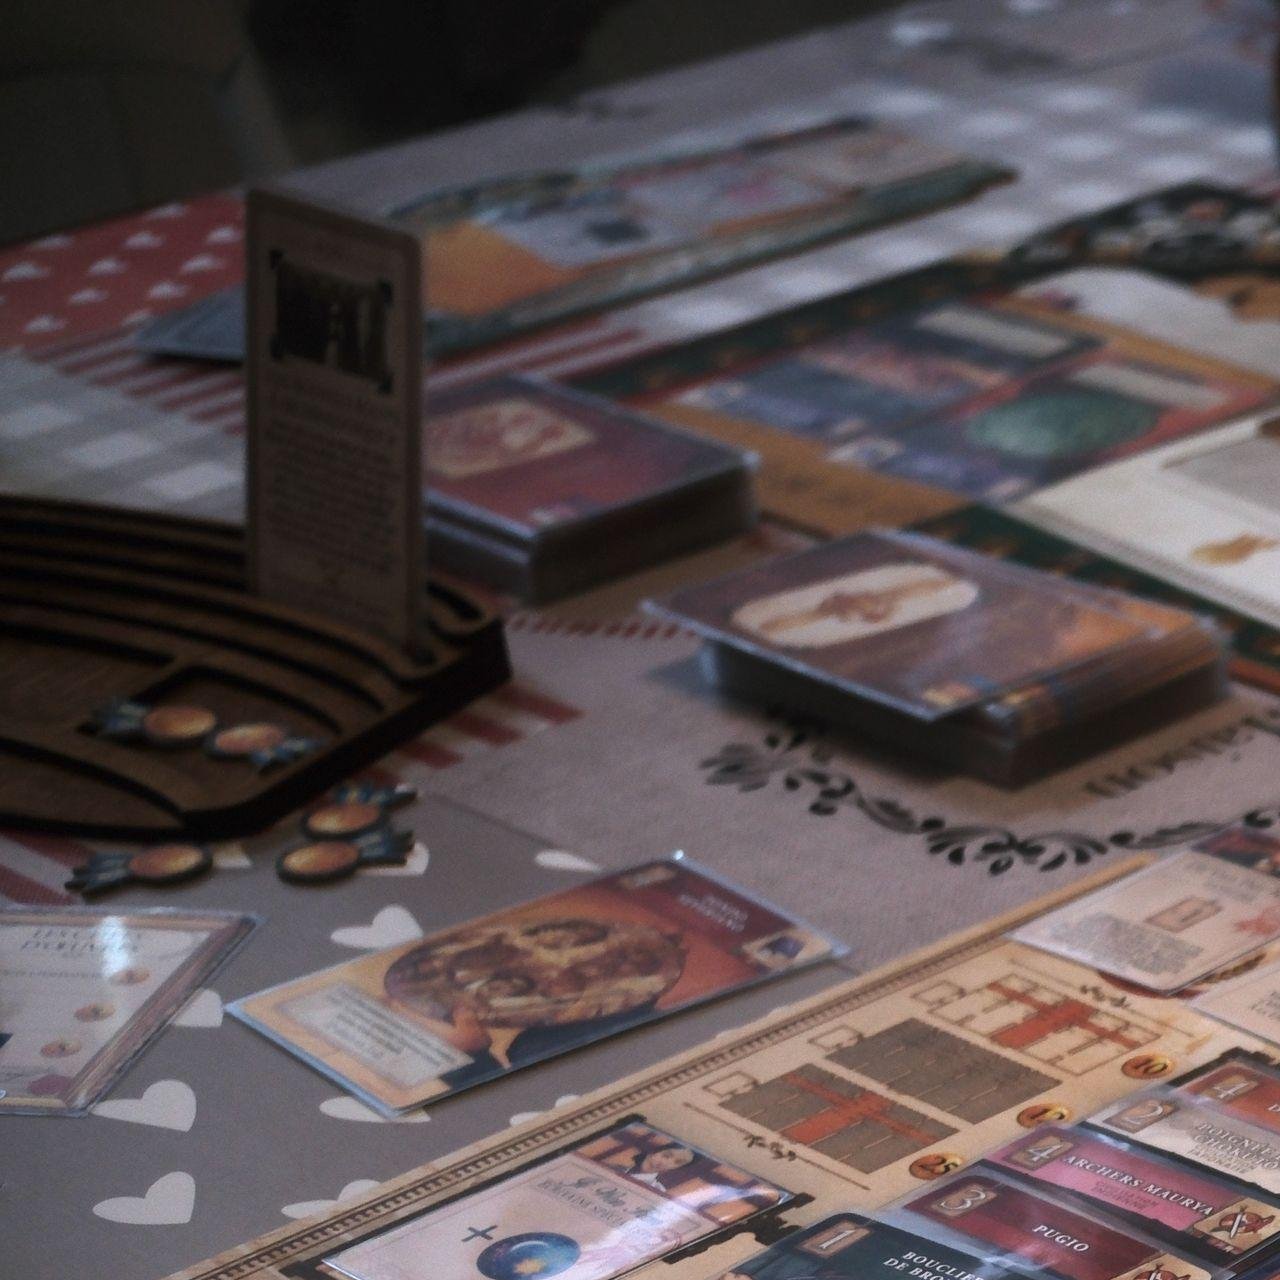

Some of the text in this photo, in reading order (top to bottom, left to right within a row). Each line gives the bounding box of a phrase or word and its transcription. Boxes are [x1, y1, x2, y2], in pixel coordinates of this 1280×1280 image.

[1212, 1080, 1248, 1100] 4
[1132, 1103, 1164, 1125] 2
[1025, 1143, 1062, 1163] 4
[1063, 1153, 1215, 1216] ARCHERS MAURYA
[944, 1188, 987, 1212] 3
[818, 1229, 856, 1250] 1
[1032, 1223, 1090, 1254] PUGIO
[883, 1257, 905, 1272] DE
